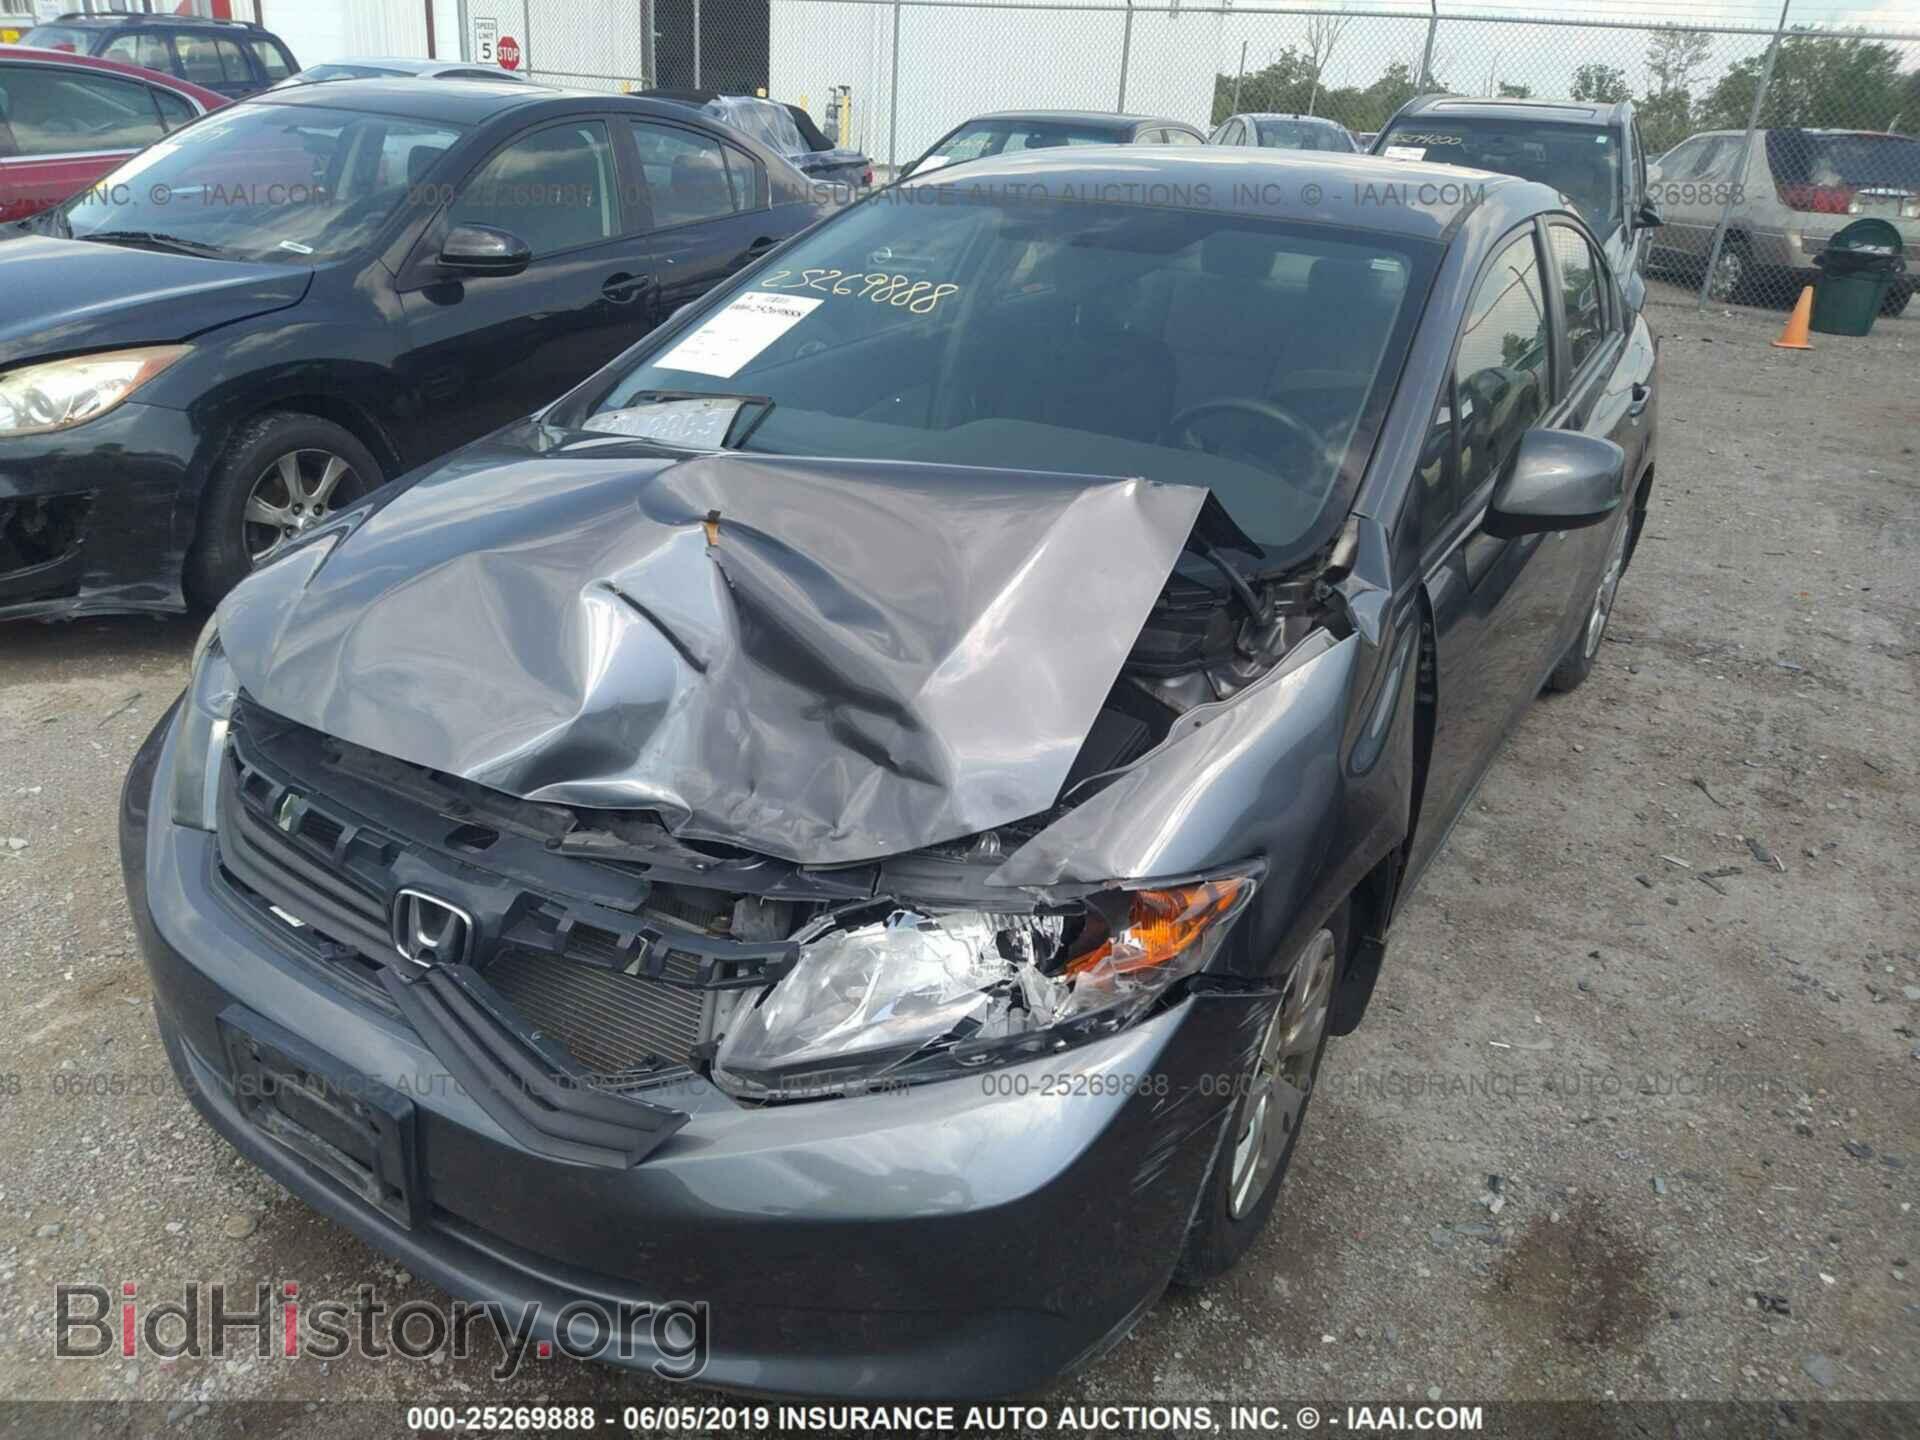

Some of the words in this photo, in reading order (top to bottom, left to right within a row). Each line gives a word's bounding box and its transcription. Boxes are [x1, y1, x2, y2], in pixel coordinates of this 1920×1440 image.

[482, 42, 492, 59] 5
[498, 47, 519, 61] STOP
[761, 269, 959, 313] 25269888
